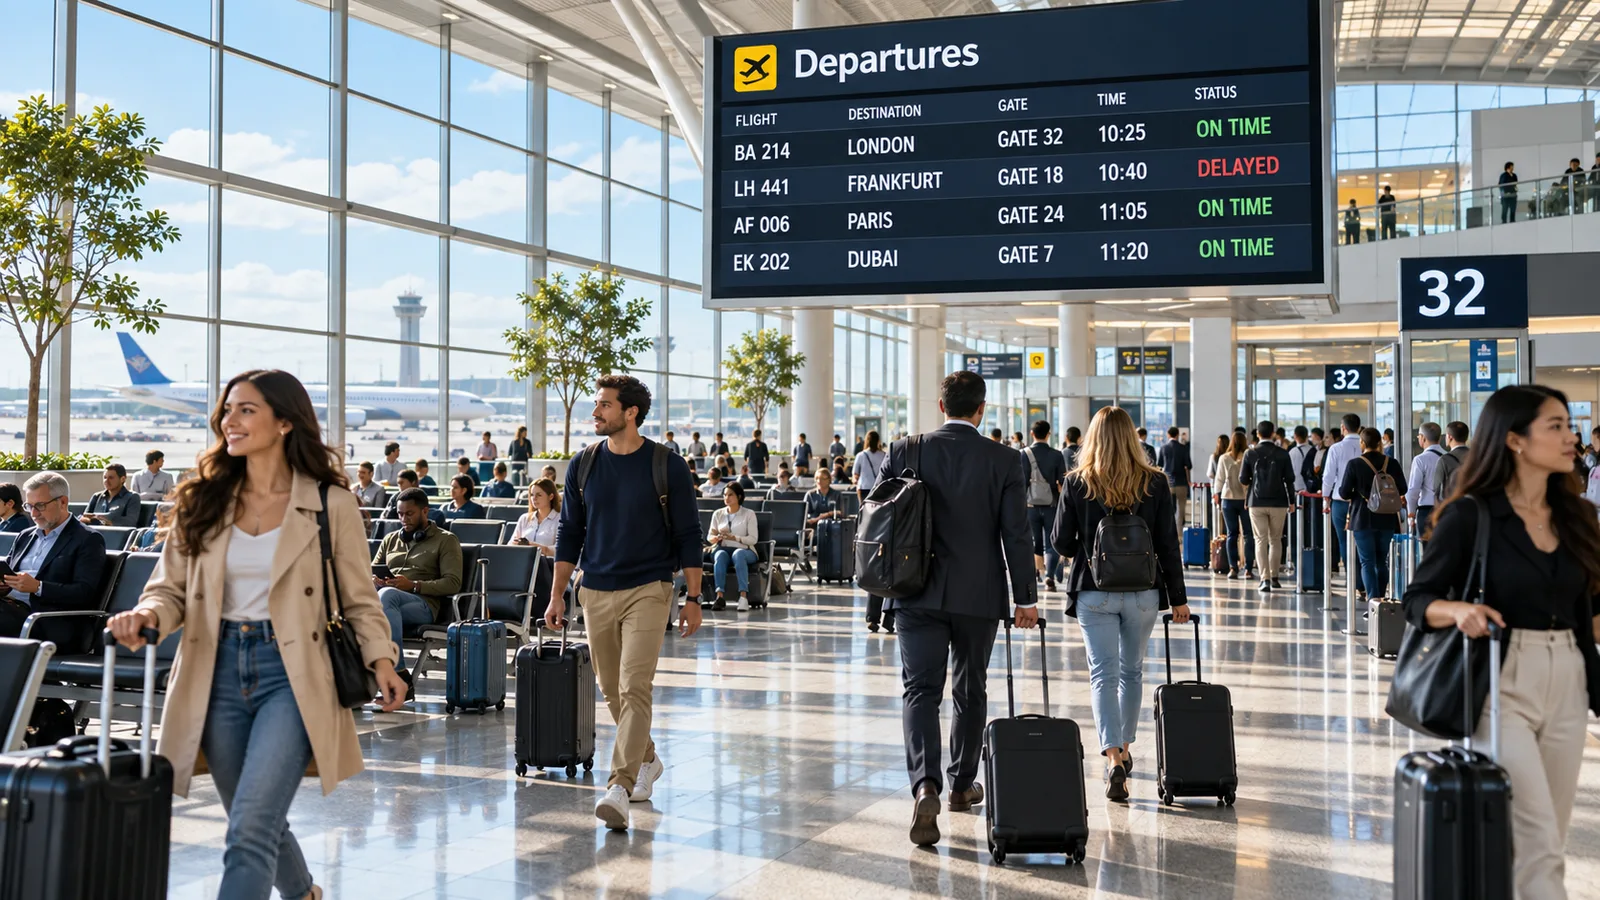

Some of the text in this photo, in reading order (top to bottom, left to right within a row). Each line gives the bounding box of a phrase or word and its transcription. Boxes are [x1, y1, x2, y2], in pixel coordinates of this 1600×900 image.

[796, 43, 979, 82] Departures
[736, 86, 1237, 126] FLIGHT DESTINATION GATE TIME STATUS
[735, 117, 1271, 161] BA 214 LONDON GATE 32 10:25 ON TIME
[735, 156, 1279, 197] LH 441 FRANKFURT GATE 18 10:40 DELAYED
[734, 197, 1272, 234] AF 006 PARIS GATE 24 11:05 ON TIME
[734, 238, 1274, 271] EK 202 DUBAI GATE 7 11:20 ON TIME
[1419, 269, 1485, 317] 32
[1333, 369, 1359, 389] 32
